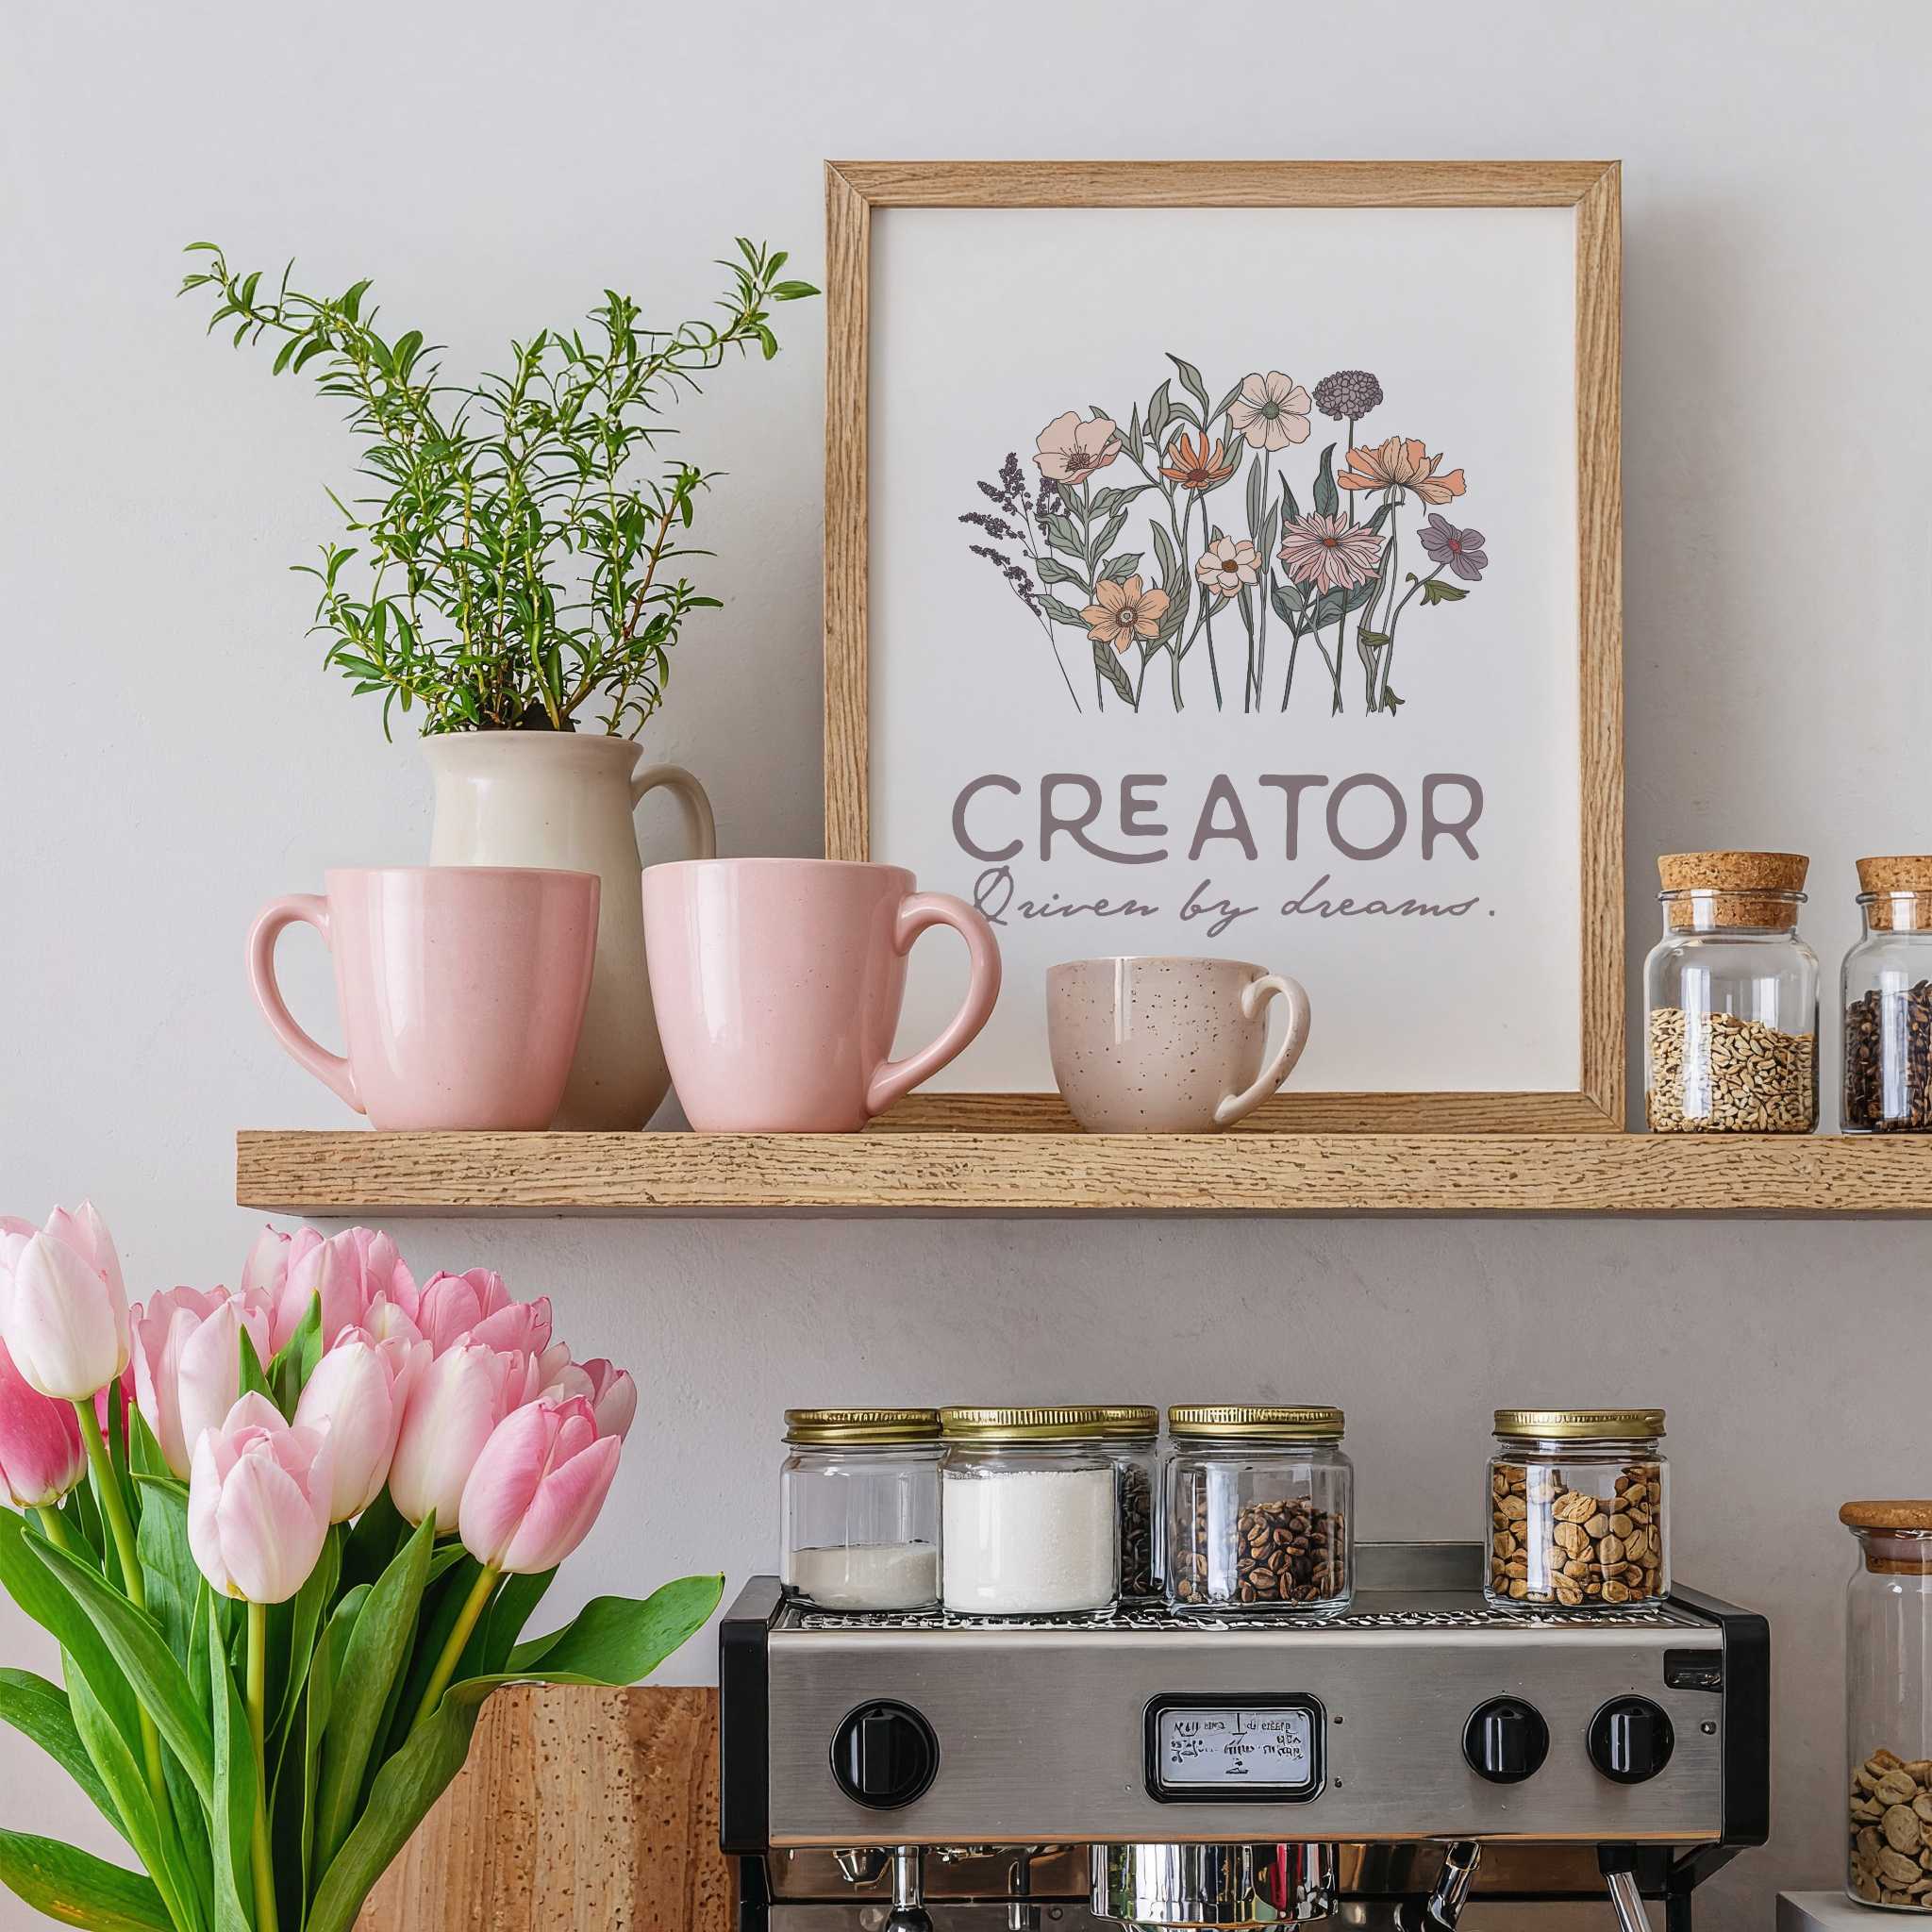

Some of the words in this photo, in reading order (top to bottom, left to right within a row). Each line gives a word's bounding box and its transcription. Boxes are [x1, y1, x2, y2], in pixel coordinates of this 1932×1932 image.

[951, 773, 1484, 865] CREATOR
[1179, 878, 1259, 939] by
[1280, 874, 1496, 919] dreams.
